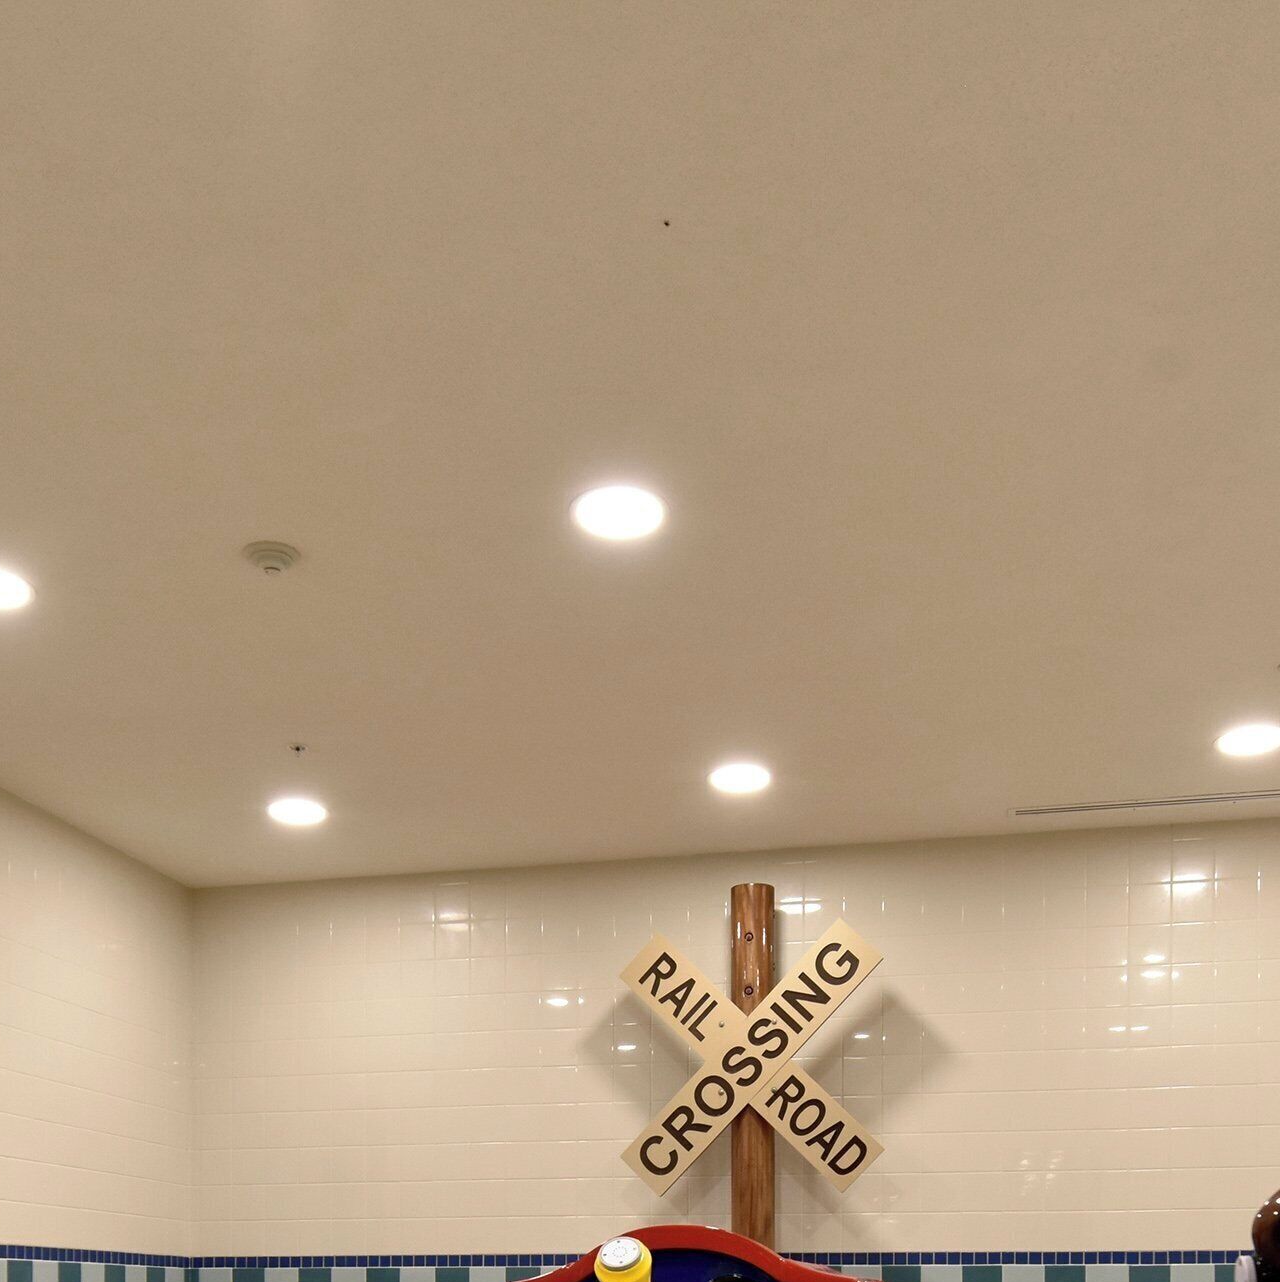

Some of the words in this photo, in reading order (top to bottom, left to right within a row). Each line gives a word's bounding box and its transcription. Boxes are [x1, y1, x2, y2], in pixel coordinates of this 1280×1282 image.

[639, 952, 718, 1042] RAIL
[765, 1075, 868, 1176] ROAD
[640, 942, 860, 1176] CROSSING
